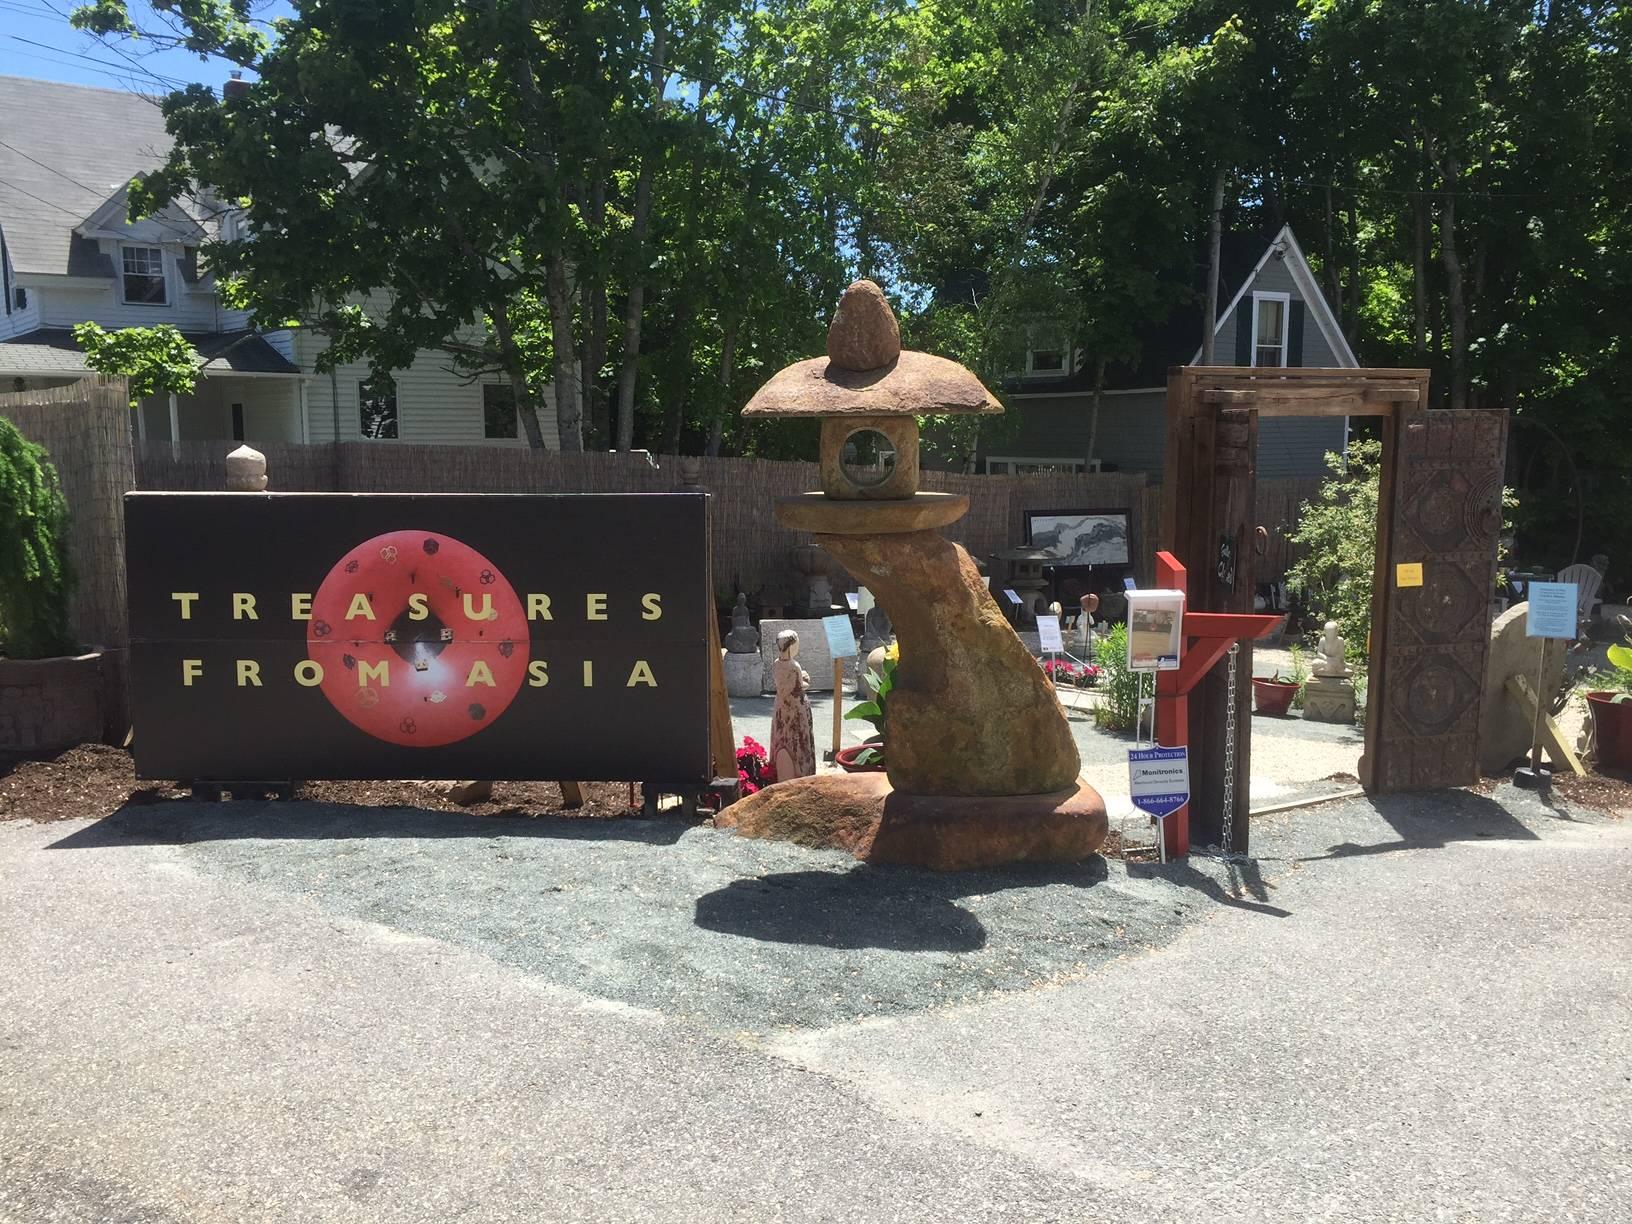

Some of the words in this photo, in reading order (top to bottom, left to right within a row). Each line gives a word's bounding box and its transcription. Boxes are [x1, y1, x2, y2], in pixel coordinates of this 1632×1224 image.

[172, 592, 663, 621] TREASURES
[182, 659, 391, 688] FROM
[465, 659, 658, 688] ASIA
[1130, 752, 1137, 760] 24
[1154, 751, 1185, 759] PROTECTION
[1142, 768, 1183, 776] Monitronics
